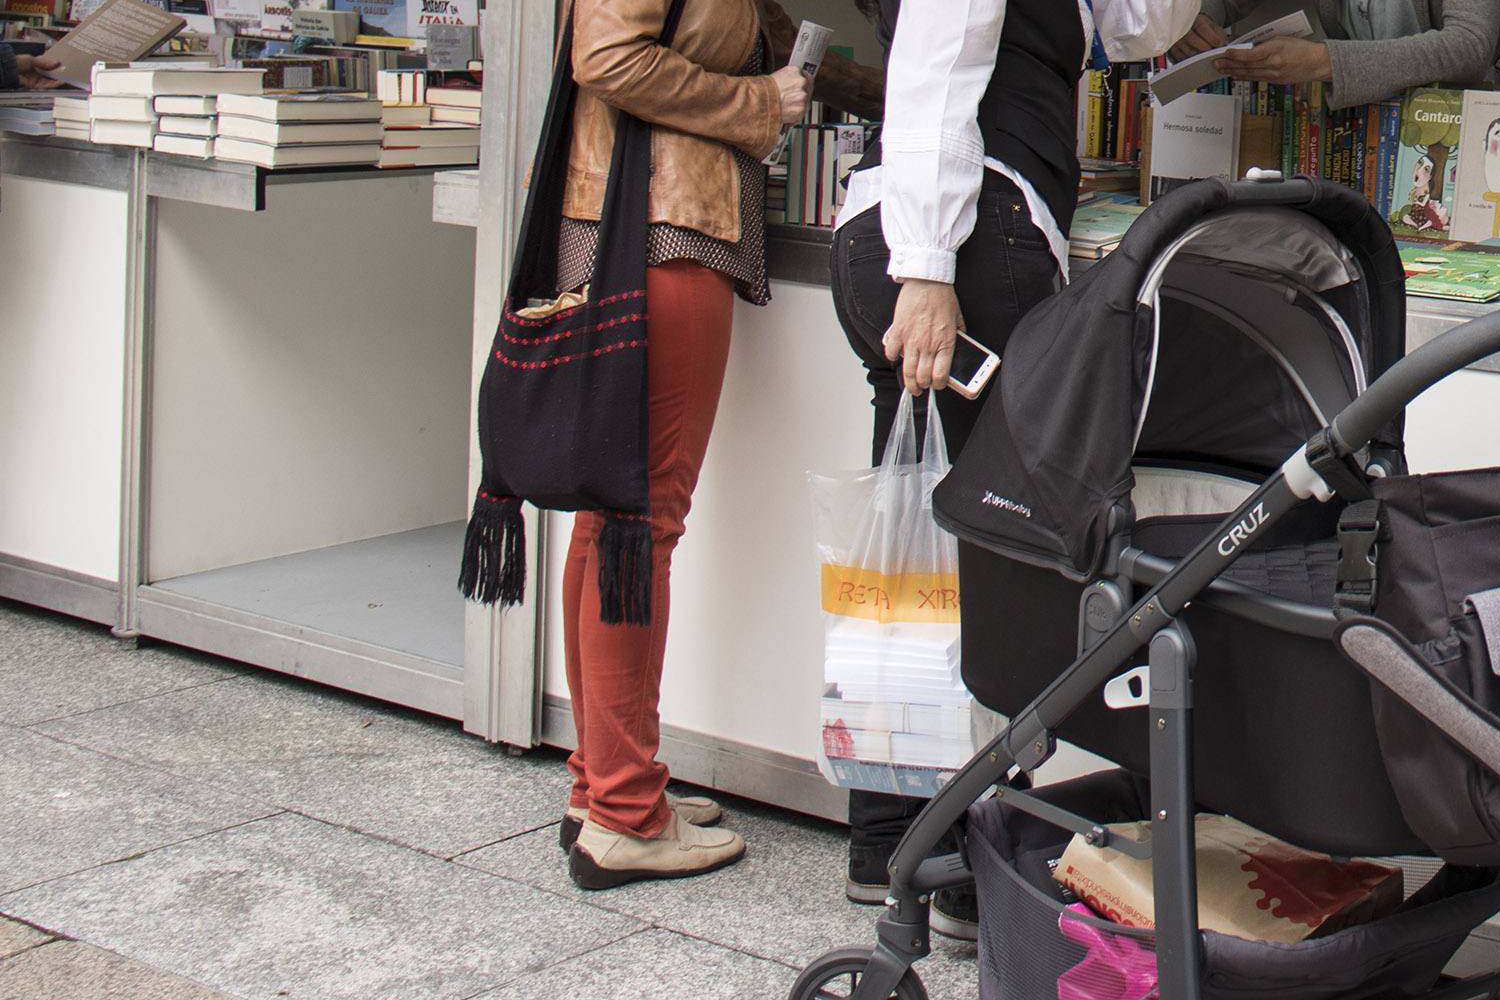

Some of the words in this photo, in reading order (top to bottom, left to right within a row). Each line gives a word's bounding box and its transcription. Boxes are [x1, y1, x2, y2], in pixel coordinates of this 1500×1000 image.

[1163, 123, 1193, 132] Hermosa
[1195, 124, 1223, 135] soledad
[1414, 109, 1461, 124] Cantaro
[1333, 152, 1341, 183] CIENCIA
[1217, 502, 1270, 557] CRUZ
[838, 582, 891, 610] RETA
[918, 588, 961, 610] XIR
